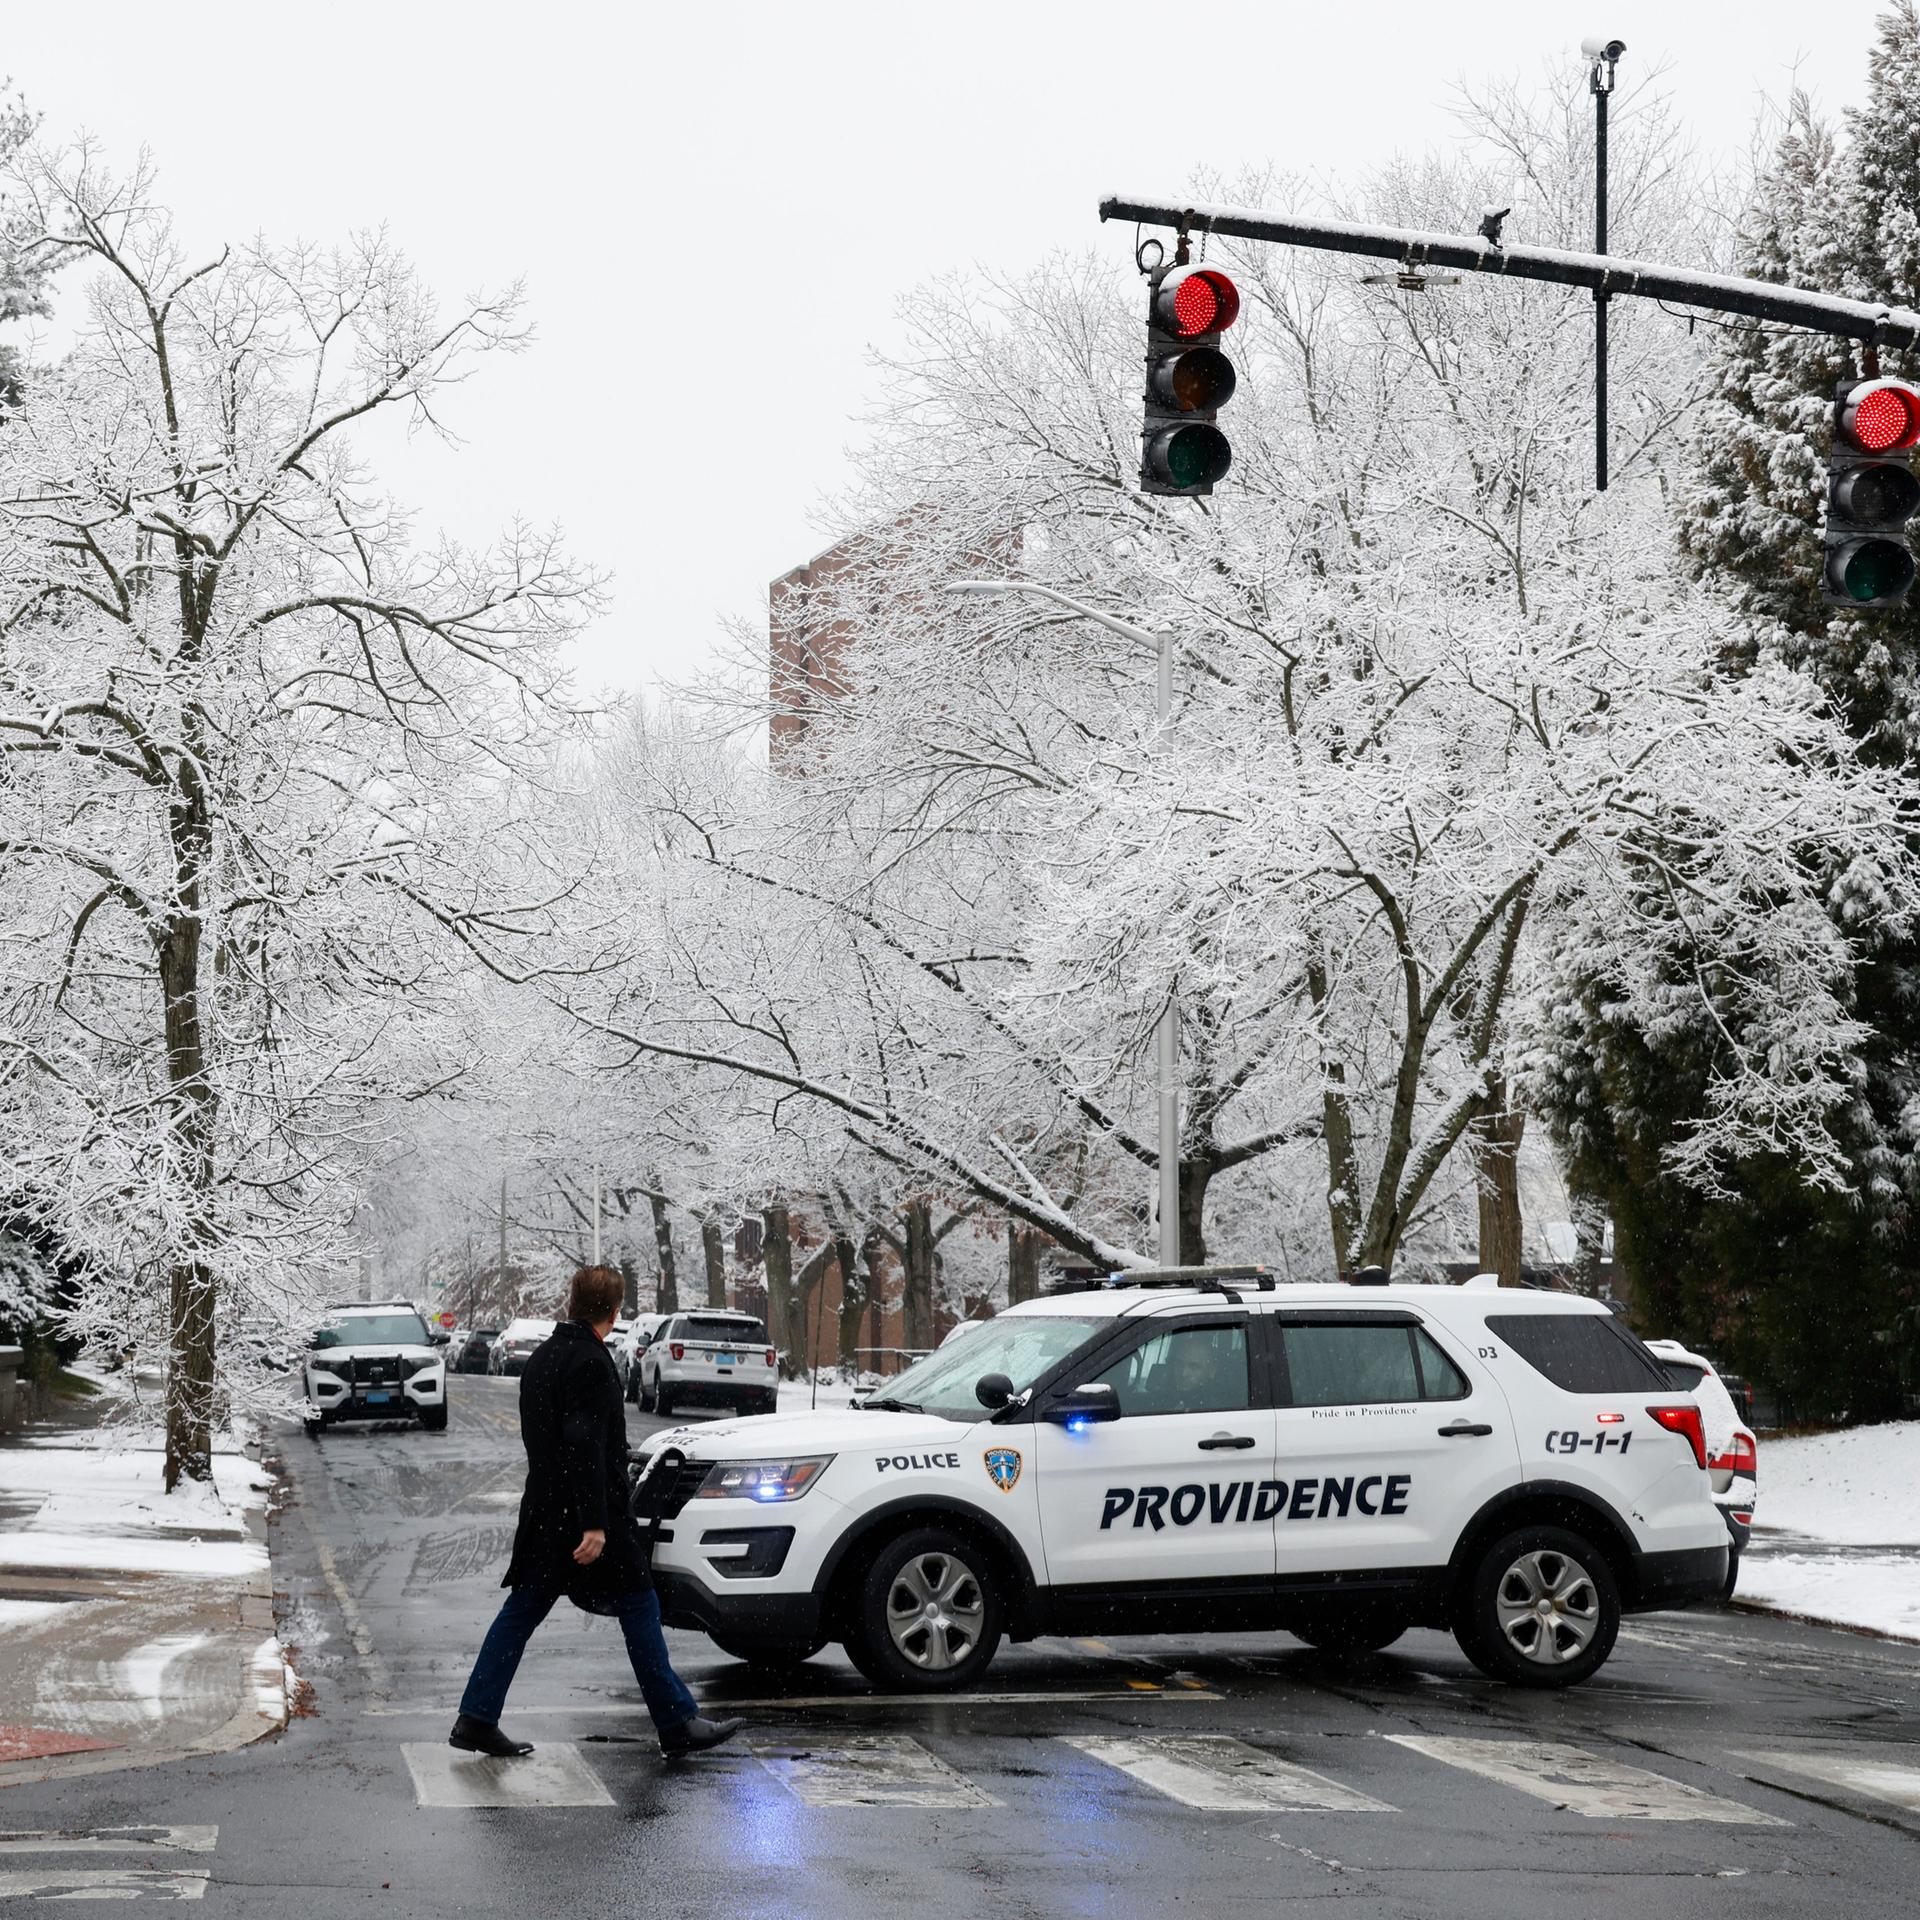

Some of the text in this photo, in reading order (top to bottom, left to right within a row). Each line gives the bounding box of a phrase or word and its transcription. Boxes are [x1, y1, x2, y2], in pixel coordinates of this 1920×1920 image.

[1478, 1346, 1498, 1358] D3
[1312, 1406, 1418, 1418] Pride in Providence
[875, 1453, 961, 1472] POLICE
[1100, 1475, 1411, 1531] PROVIDENCE
